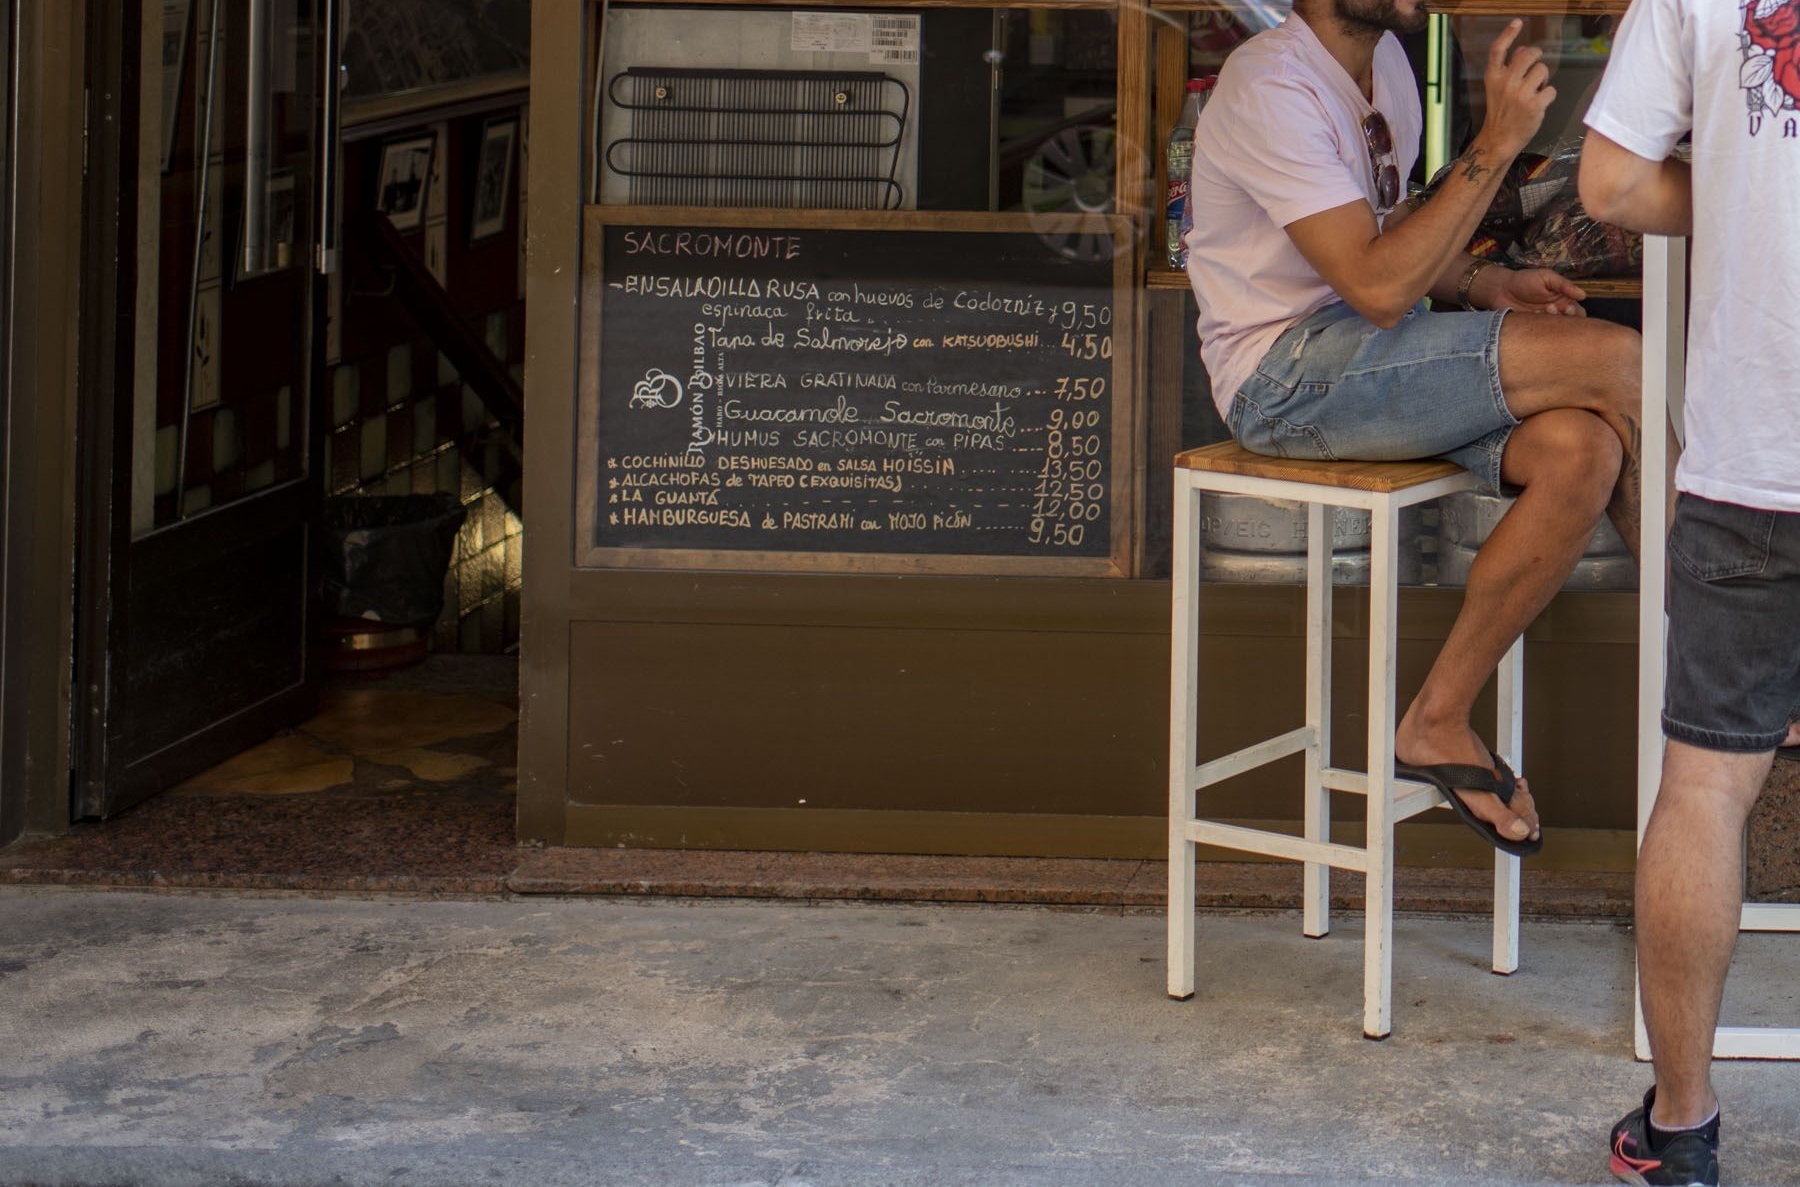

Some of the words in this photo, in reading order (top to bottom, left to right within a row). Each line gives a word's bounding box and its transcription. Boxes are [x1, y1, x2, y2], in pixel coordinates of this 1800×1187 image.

[624, 231, 801, 260] SACROMONTE
[702, 302, 788, 327] espinaca
[805, 302, 861, 326] frita
[766, 279, 820, 301] RUSA
[827, 290, 851, 303] con
[854, 283, 914, 309] huevos
[922, 292, 944, 309] de
[953, 290, 1046, 316] Codorniz
[1060, 301, 1112, 331] 9,50
[687, 322, 713, 390] BILBAO
[761, 321, 785, 348] de
[793, 326, 908, 357] Salmorejo
[912, 337, 935, 348] con
[1060, 332, 1113, 360] 4,50
[717, 352, 725, 372] ALTA
[726, 372, 787, 390] VIERA
[800, 372, 896, 390] GRATINADA
[901, 380, 925, 394] con
[925, 373, 1022, 399] Parmesano
[1053, 377, 1106, 401] 7,50
[686, 392, 713, 457] RAMÓN
[724, 395, 859, 424] Guacamole
[879, 400, 1016, 438] Sacromonte
[1046, 409, 1100, 430] 9,00
[716, 429, 780, 448] HUMUS
[792, 429, 918, 450] SACROMONTE
[925, 438, 945, 447] con
[1048, 430, 1100, 460] 8,50
[717, 455, 814, 472] DESHUESADO
[817, 461, 832, 473] en
[836, 459, 877, 473] SALSA
[1037, 458, 1102, 482] 13,50
[621, 472, 721, 487] ALCACHOFAS
[725, 473, 744, 488] de
[747, 474, 796, 489] TAPEO
[1033, 479, 1104, 502] 12,50
[621, 489, 643, 502] LA
[1031, 497, 1101, 521] 12,00
[761, 512, 779, 531] de
[861, 518, 881, 531] con
[888, 513, 927, 531] MOJO
[1027, 518, 1085, 546] 9,50
